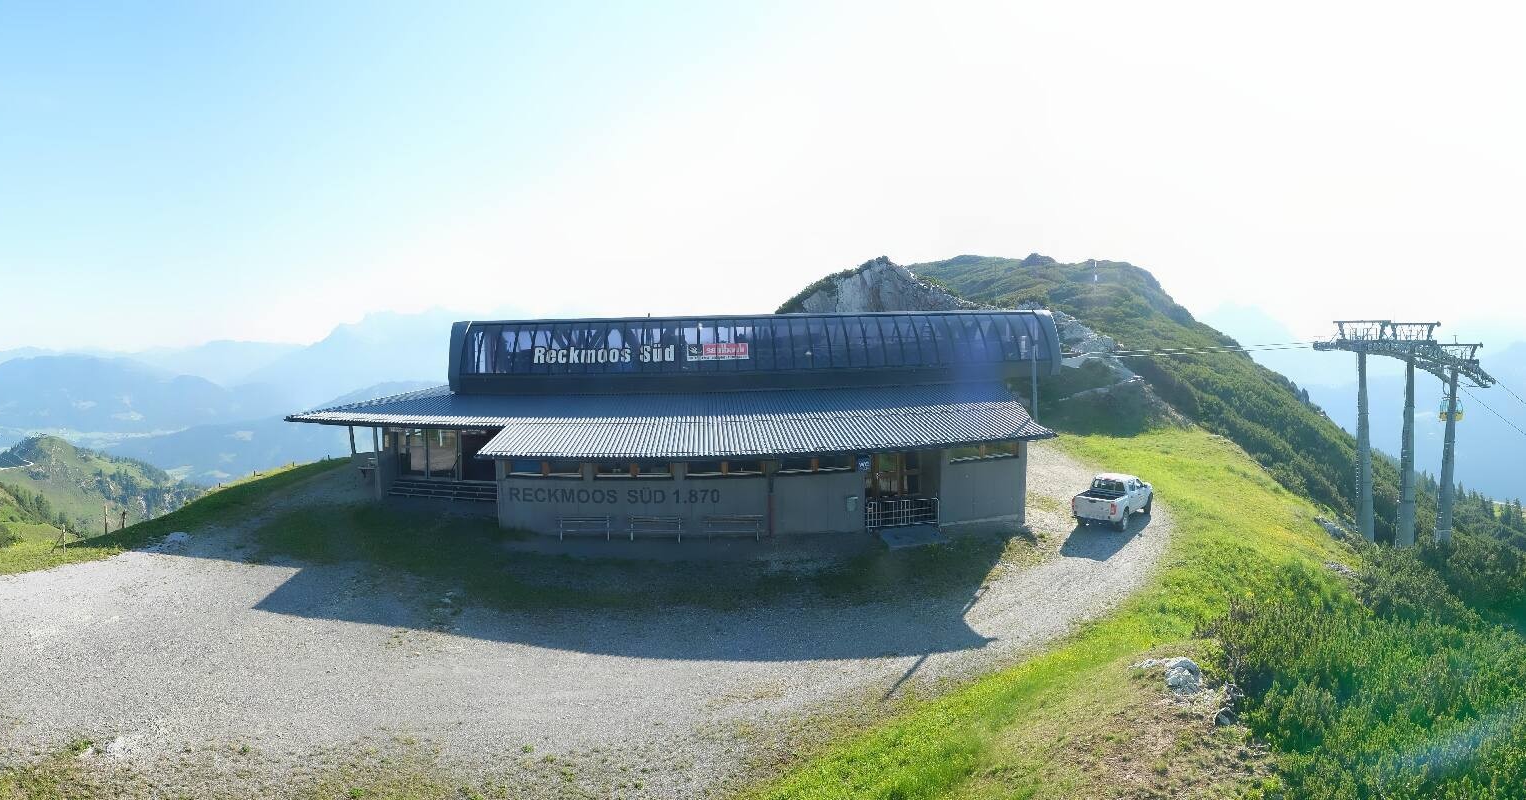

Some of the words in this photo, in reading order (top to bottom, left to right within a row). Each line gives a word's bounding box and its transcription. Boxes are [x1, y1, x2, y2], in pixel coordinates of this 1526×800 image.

[533, 346, 631, 364] Reckmoos
[640, 344, 675, 363] Süd
[508, 486, 618, 504] RECKMOOS
[626, 486, 666, 504] SÜD
[672, 488, 720, 504] 1.870
